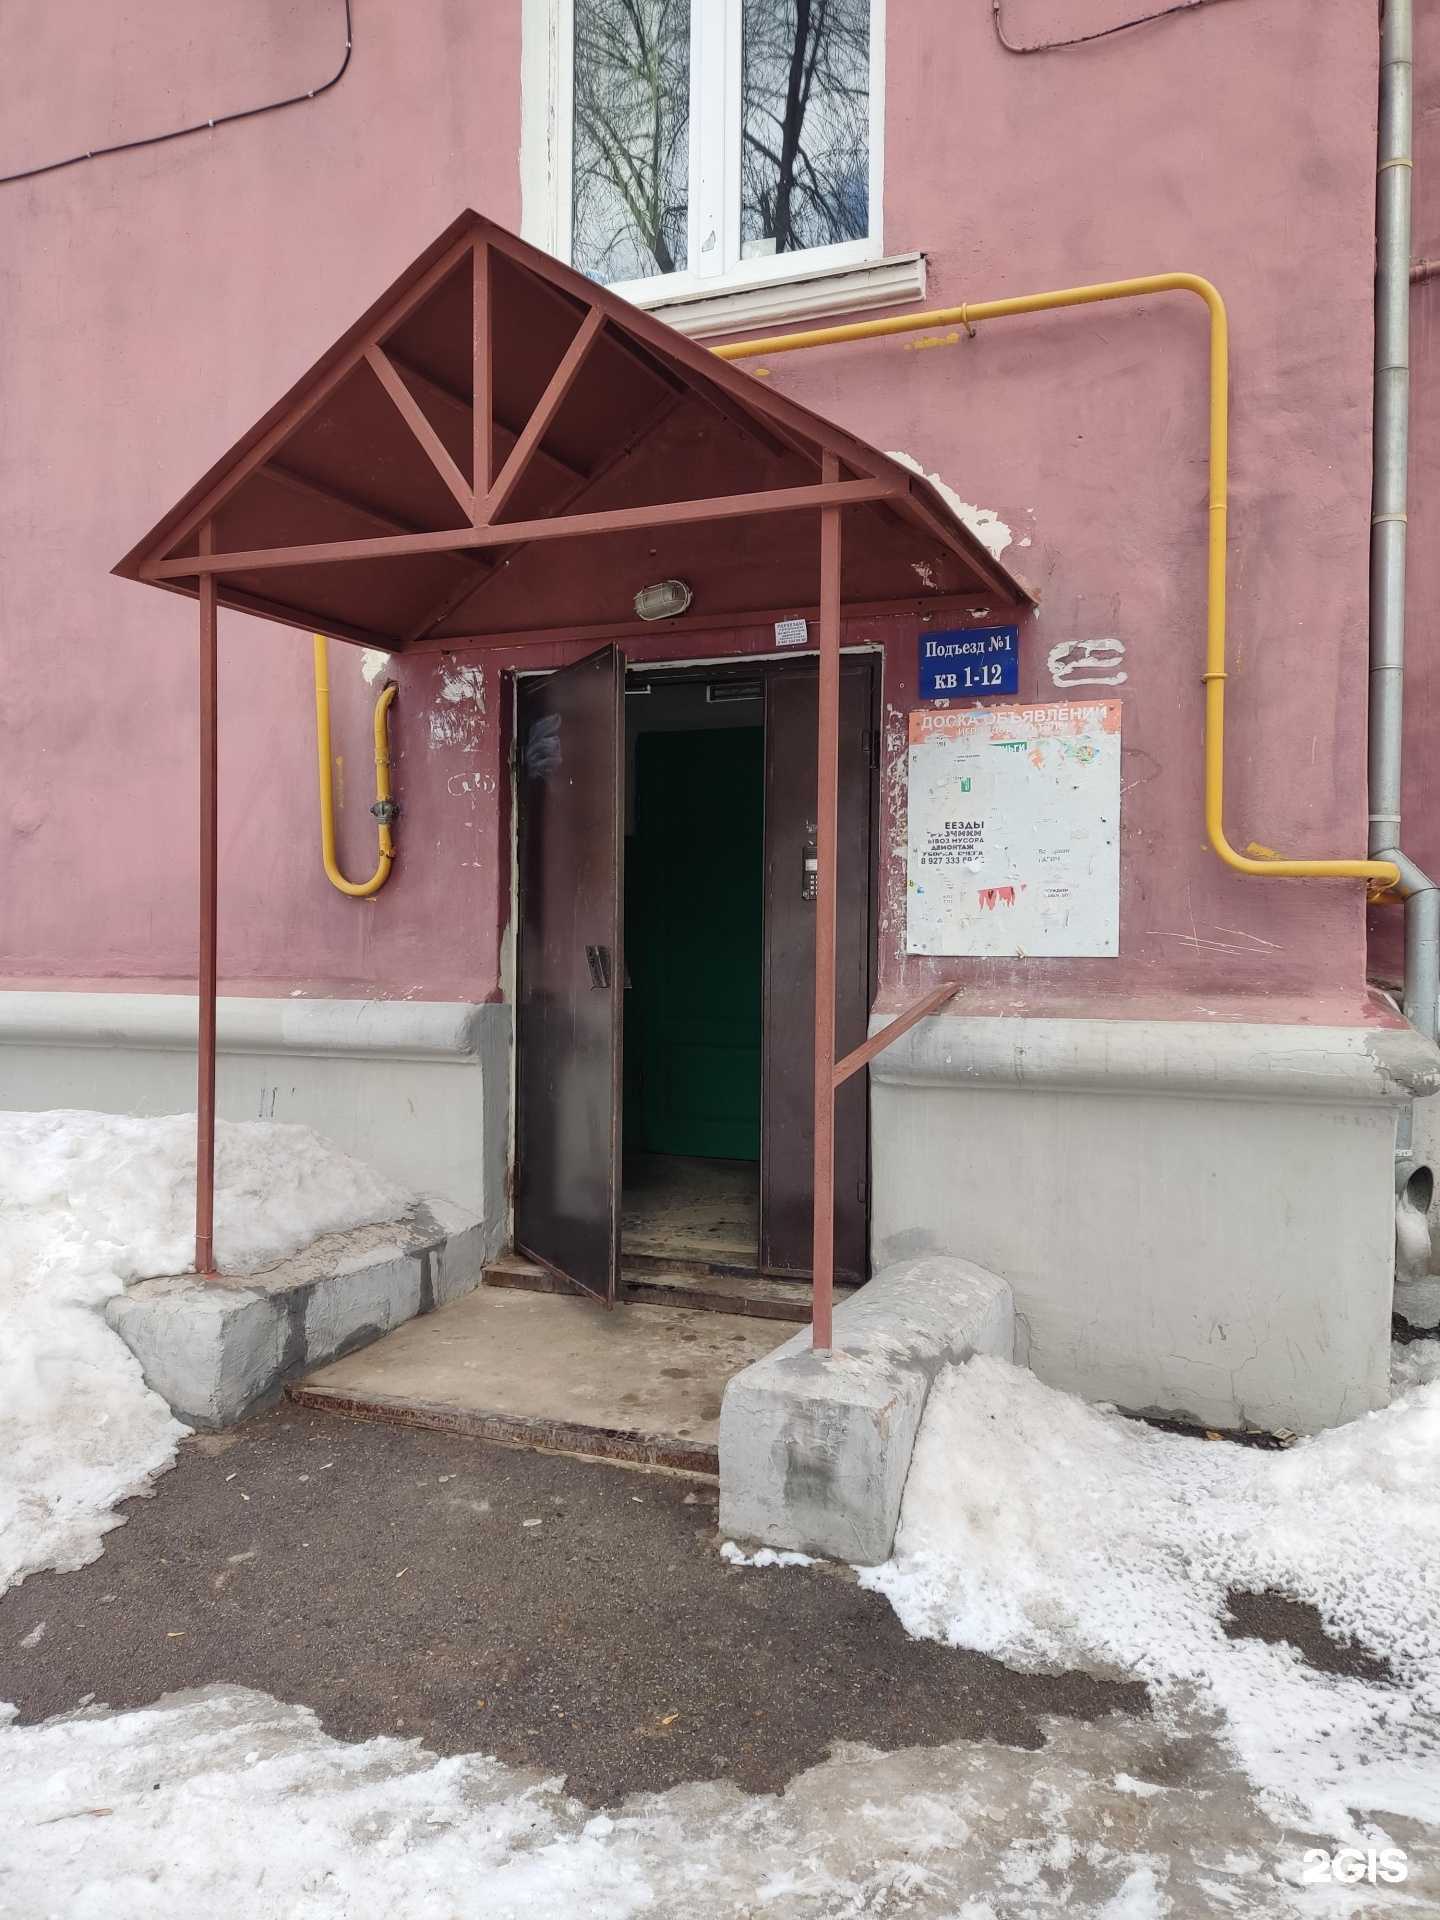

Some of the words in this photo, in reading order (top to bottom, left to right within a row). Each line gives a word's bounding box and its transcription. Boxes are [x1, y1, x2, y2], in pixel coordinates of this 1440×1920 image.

[925, 641, 985, 658] Подъезд
[988, 635, 1012, 652] №1
[934, 673, 957, 689] кв
[964, 664, 1002, 687] 1-12
[921, 713, 976, 731] ДОСКА
